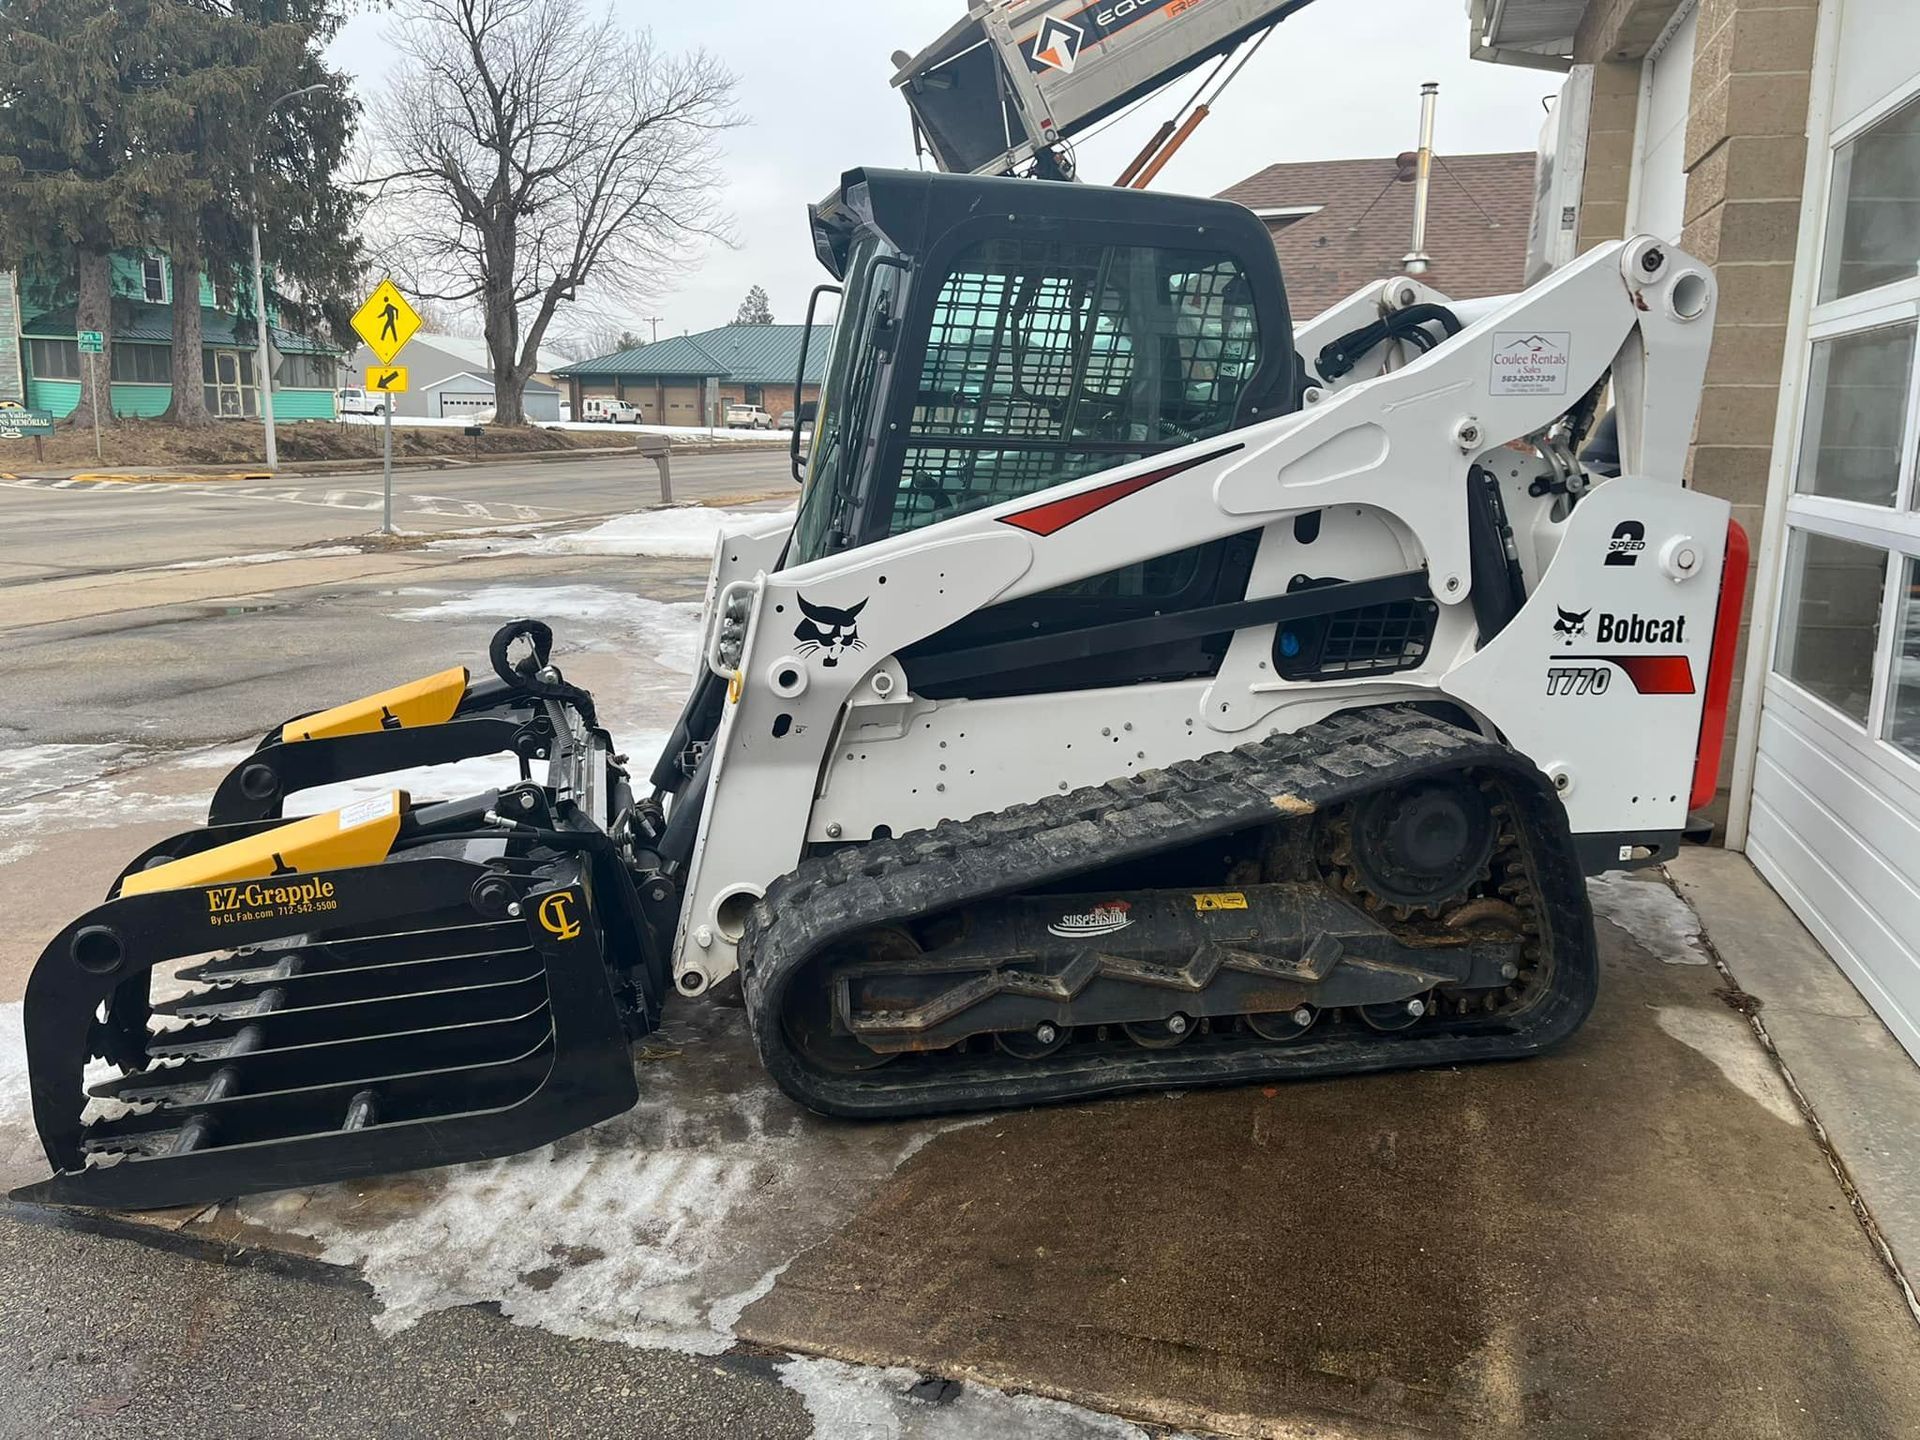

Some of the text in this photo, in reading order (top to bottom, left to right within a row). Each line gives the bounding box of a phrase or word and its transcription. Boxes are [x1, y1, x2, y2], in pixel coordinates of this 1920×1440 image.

[1494, 353, 1566, 365] Coulee Rentals
[9, 412, 33, 420] Valley
[10, 418, 50, 427] MEMORIAL
[1604, 520, 1645, 566] 2
[1608, 541, 1646, 550] SPEED
[1596, 613, 1685, 643] Bobcat
[1547, 667, 1611, 695] T770
[205, 876, 335, 912] EZ-Grapple
[210, 899, 337, 926] By CL Fab.com 712-542-5500
[1062, 911, 1127, 927] SUSPENSION
